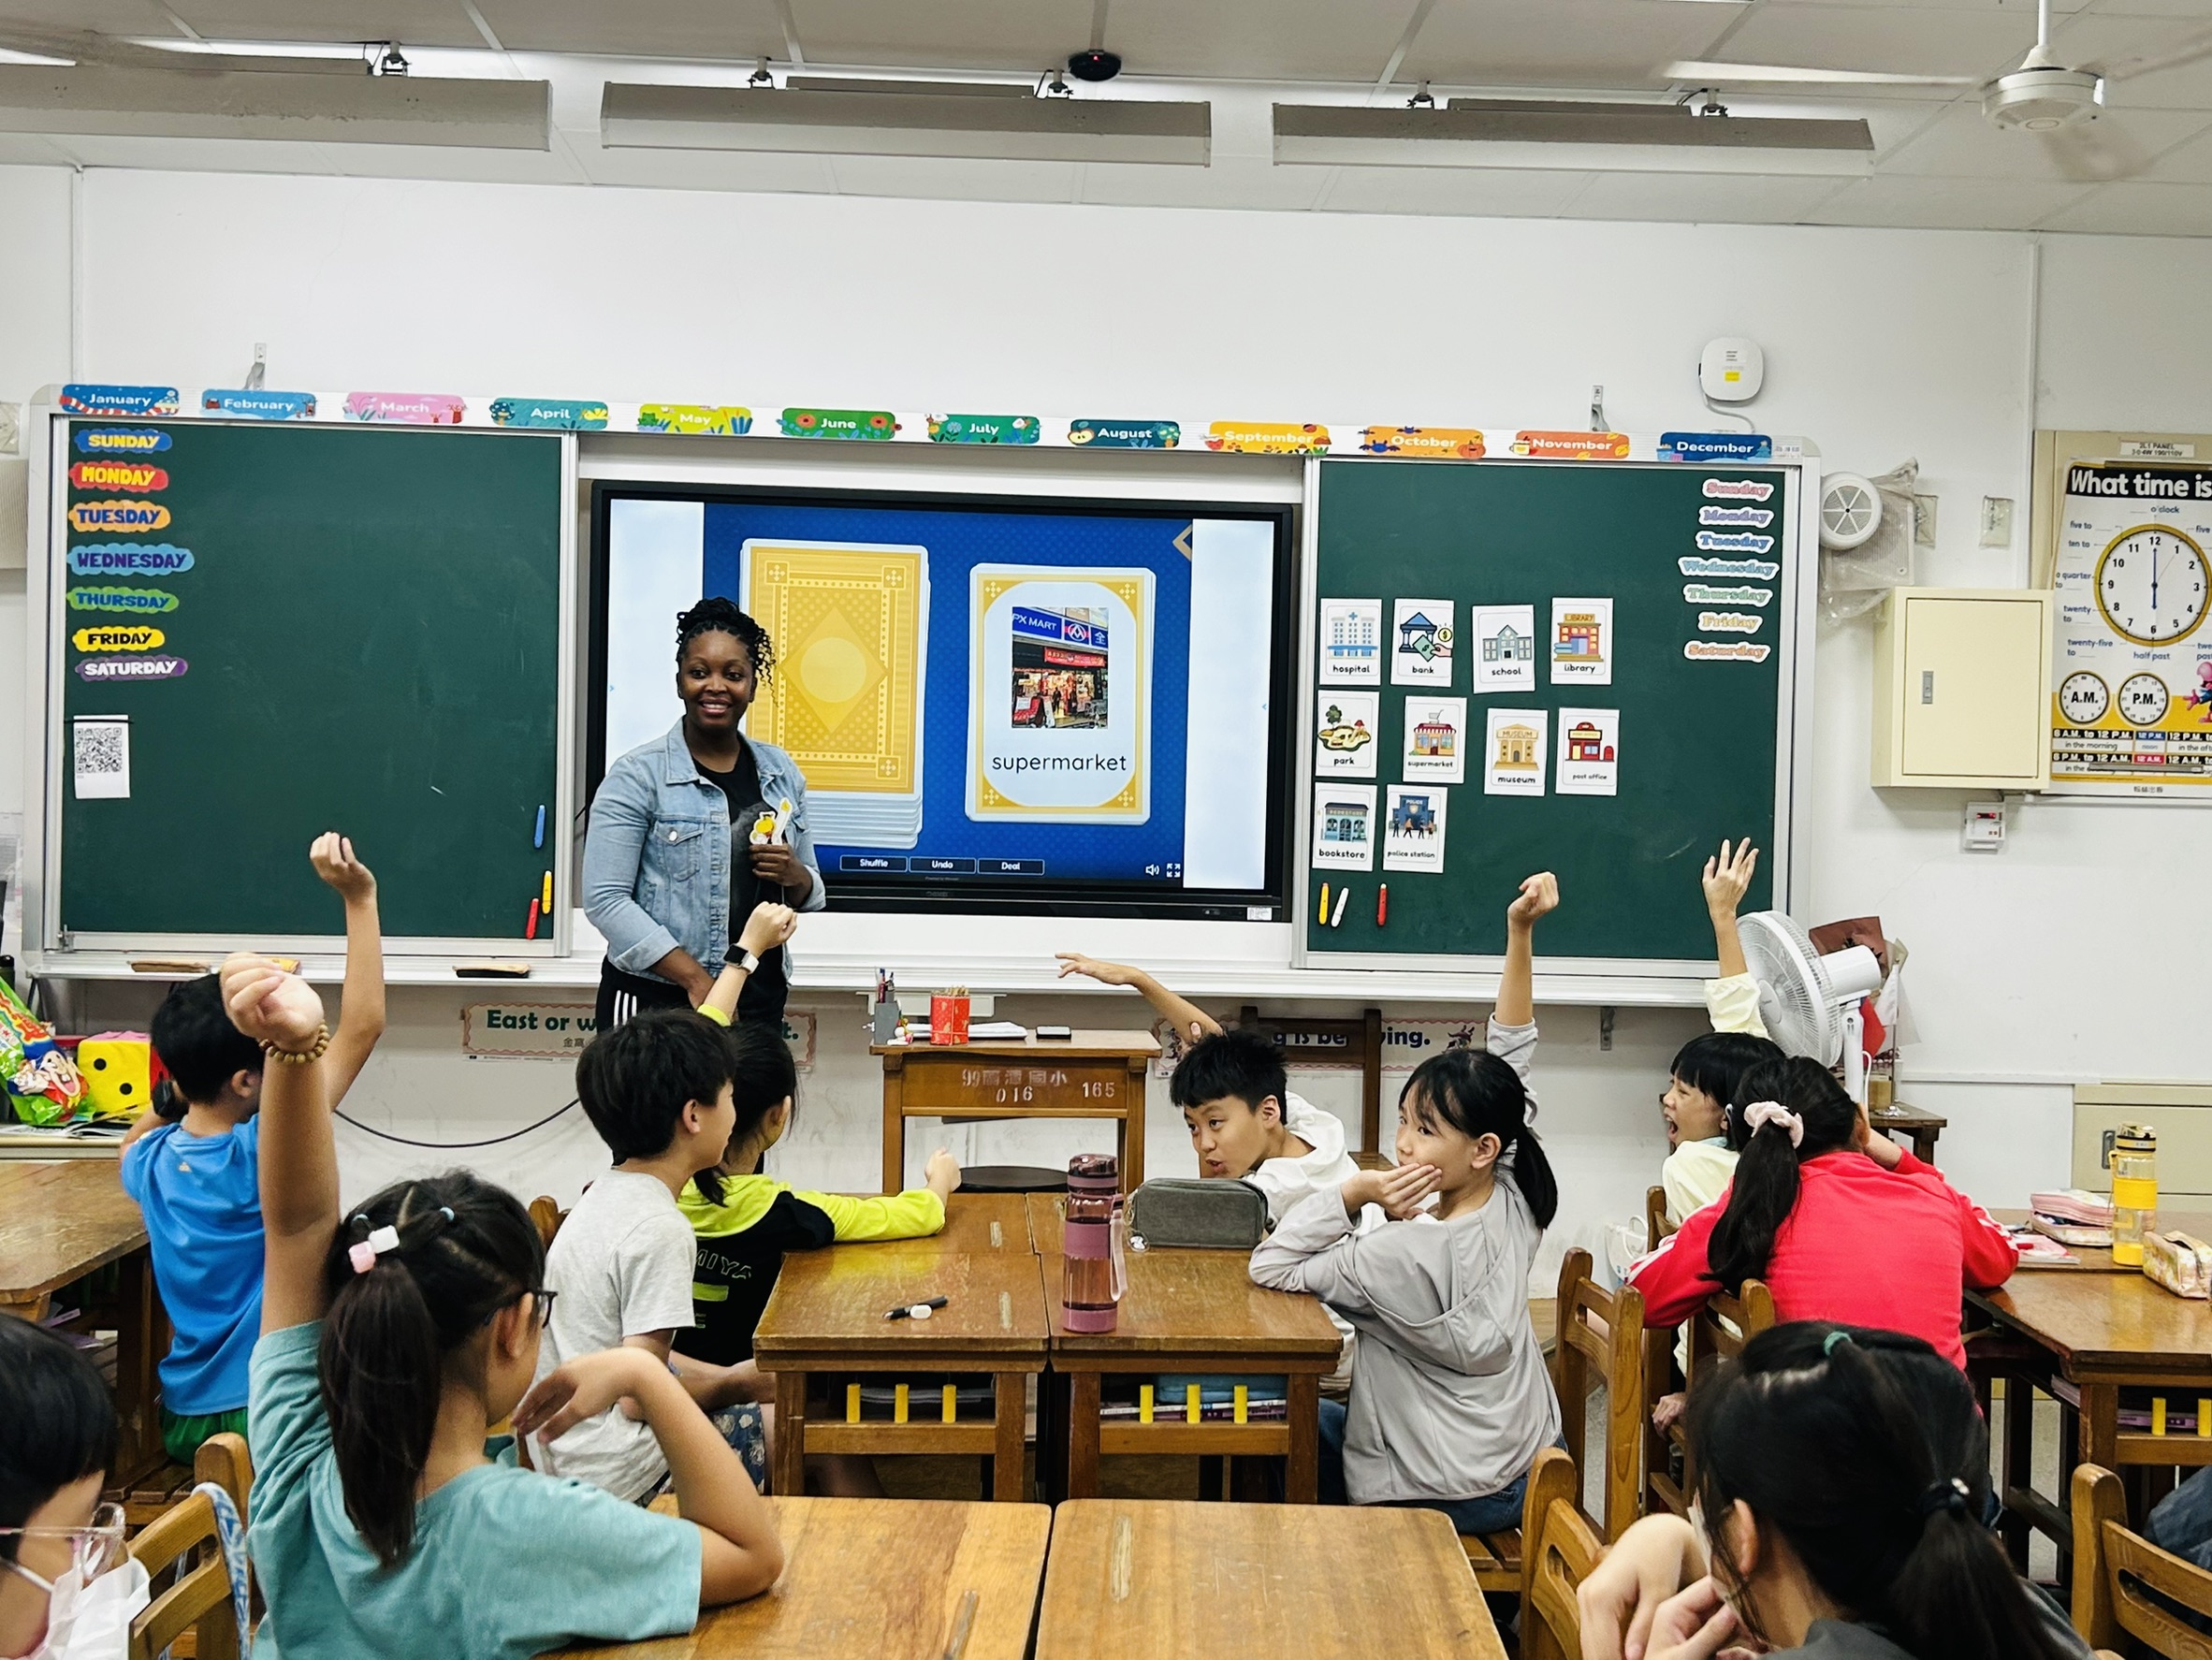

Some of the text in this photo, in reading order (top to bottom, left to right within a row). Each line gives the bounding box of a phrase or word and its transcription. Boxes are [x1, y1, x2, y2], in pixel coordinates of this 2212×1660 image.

[89, 393, 152, 407] January
[224, 399, 295, 412] February
[381, 400, 429, 414] March
[531, 406, 571, 421] April
[679, 413, 711, 427] May
[821, 417, 856, 430] June
[968, 422, 999, 436] July
[1098, 427, 1153, 441] August
[88, 434, 160, 448] SUNDAY
[1224, 431, 1313, 445] September
[1391, 436, 1457, 448] October
[1532, 439, 1613, 451] November
[1677, 442, 1754, 454] December
[81, 466, 155, 486] MONDAY
[1706, 483, 1769, 497] Sunday
[2071, 469, 2212, 499] What time is
[77, 509, 161, 524] TUESDAY
[1703, 509, 1769, 524] Monday
[2195, 525, 2210, 533] five
[1699, 534, 1769, 549] Tuesday
[2149, 536, 2161, 546] 12
[2128, 544, 2139, 552] 11
[2175, 545, 2179, 554] 1
[78, 553, 187, 569] WEDNESDAY
[2113, 559, 2125, 568] 10
[2189, 561, 2195, 570] 2
[1682, 561, 1775, 576] Wednesday
[2062, 572, 2091, 580] quarter
[2107, 579, 2115, 590] 9
[2193, 582, 2200, 591] 3
[76, 592, 170, 608] THURSDAY
[1687, 588, 1768, 603] Thursday
[2063, 605, 2091, 615] twenty
[2113, 602, 2120, 612] 8
[2187, 604, 2193, 613] 4
[1011, 613, 1056, 631] PX MART
[1702, 615, 1758, 630] Friday
[2127, 618, 2133, 627] 7
[2173, 619, 2179, 628] 5
[2150, 625, 2157, 634] 6
[88, 633, 152, 645] FRIDAY
[2068, 639, 2113, 648] twenty-five
[1688, 645, 1767, 659] Saturday
[2151, 652, 2170, 661] past
[84, 661, 178, 677] SATURDAY
[1332, 663, 1370, 675] hospital
[1412, 665, 1434, 675] bank
[1492, 666, 1521, 677] school
[1564, 663, 1595, 674] library
[2071, 692, 2099, 704] A.M.
[2132, 692, 2158, 706] P.M.
[2084, 730, 2094, 738] to
[2111, 731, 2132, 739] P.M.
[2087, 742, 2117, 751] morning
[992, 753, 1127, 774] supermarket
[1333, 757, 1355, 766] park
[2083, 753, 2094, 762] to
[2110, 754, 2131, 763] A.M.
[2181, 756, 2202, 764] A.M.
[1318, 848, 1365, 859] bookstore
[859, 858, 889, 868] Shuffle
[931, 859, 953, 869] Undo
[1001, 861, 1021, 871] Deal
[487, 1009, 538, 1029] East
[545, 1016, 570, 1031] or
[996, 1085, 1033, 1103] 016
[1082, 1082, 1115, 1098] 165
